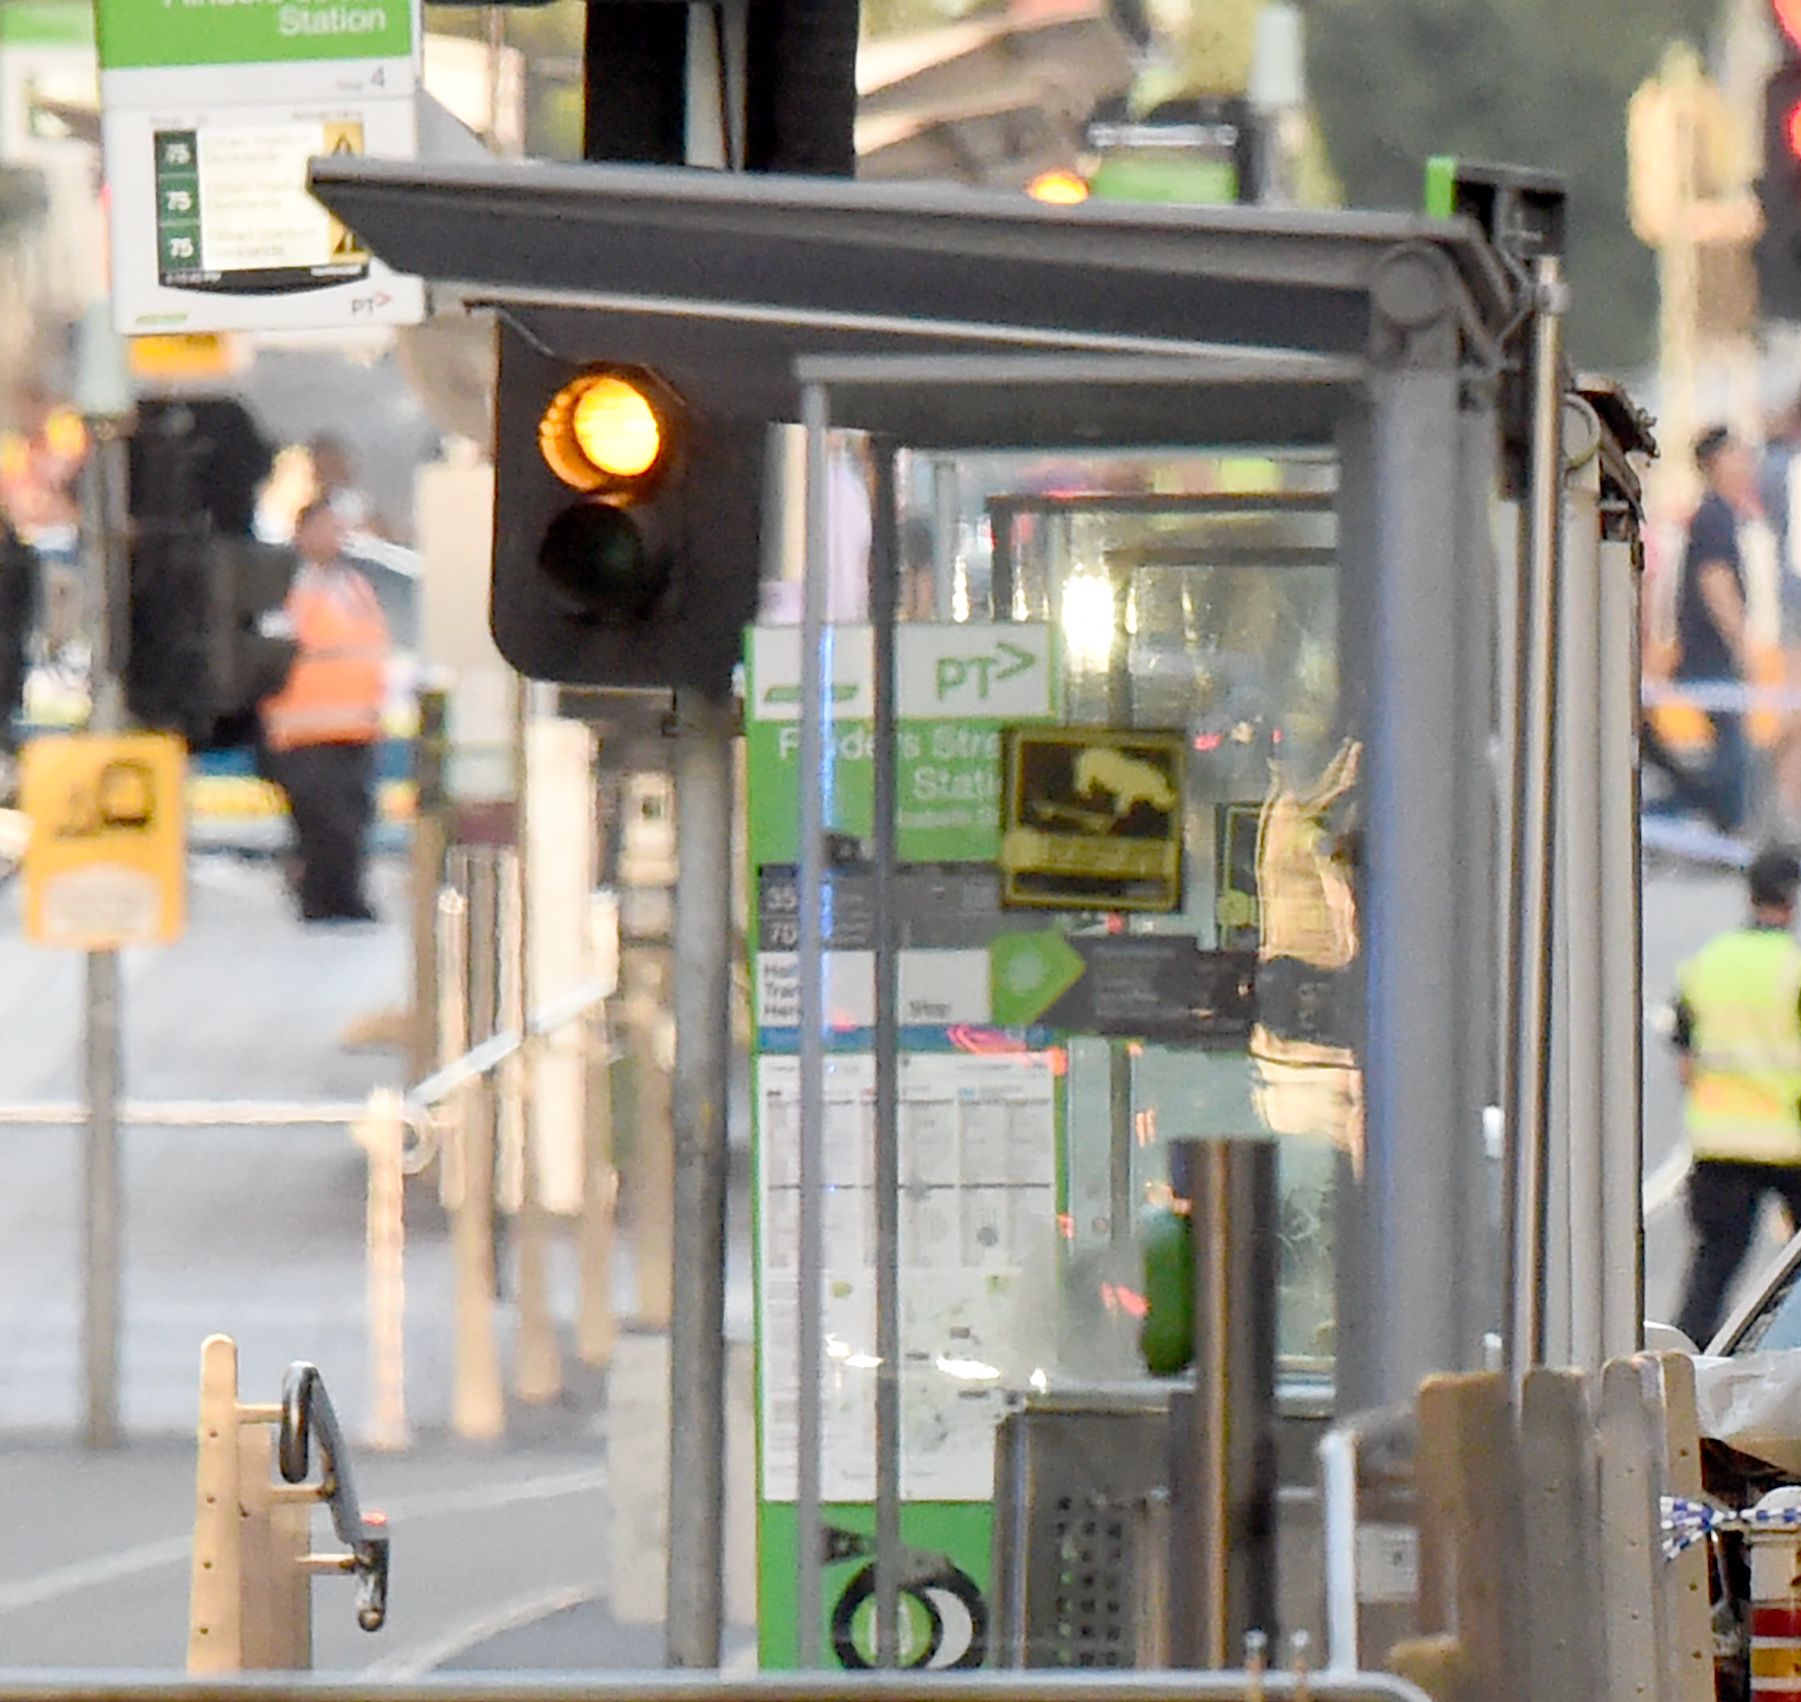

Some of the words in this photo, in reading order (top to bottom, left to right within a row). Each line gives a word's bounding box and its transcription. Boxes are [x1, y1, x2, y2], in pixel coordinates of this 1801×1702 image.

[278, 6, 387, 36] Station
[371, 66, 386, 88] 4
[165, 143, 191, 165] 75
[166, 190, 192, 211] 75
[170, 237, 194, 258] 75
